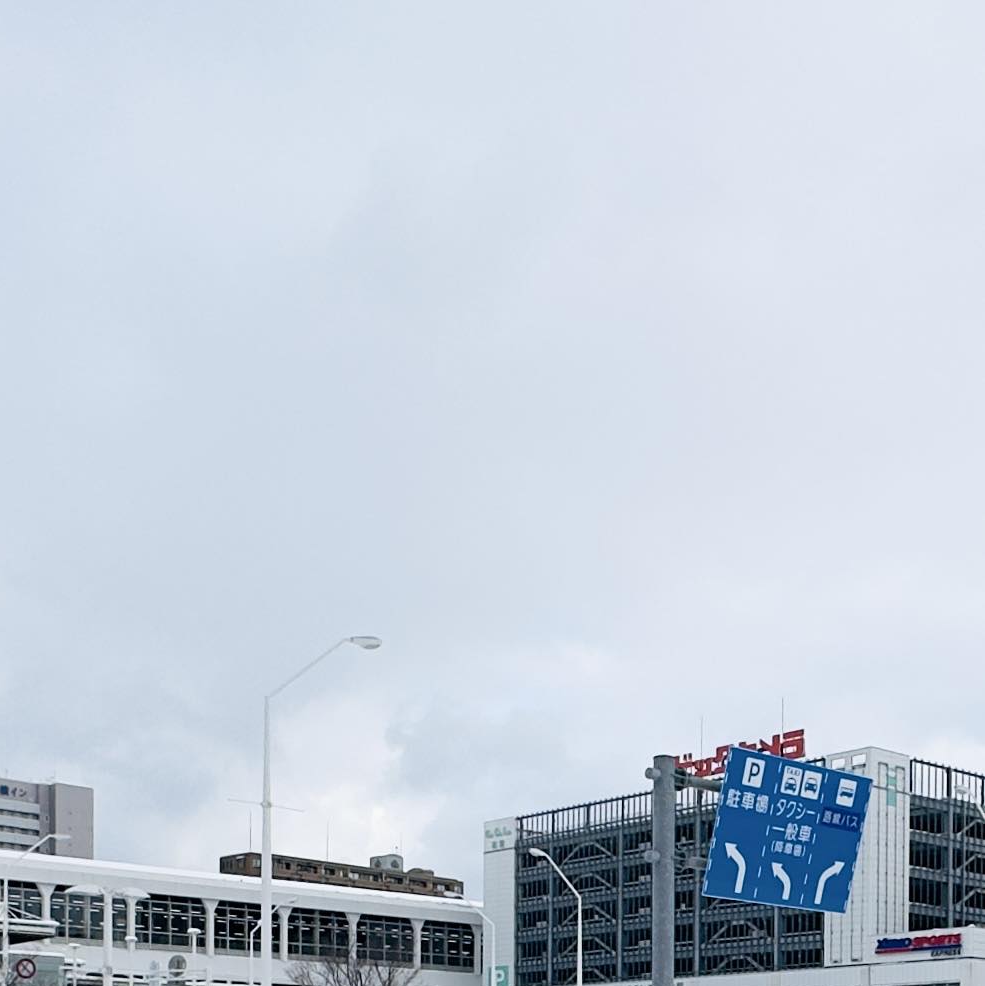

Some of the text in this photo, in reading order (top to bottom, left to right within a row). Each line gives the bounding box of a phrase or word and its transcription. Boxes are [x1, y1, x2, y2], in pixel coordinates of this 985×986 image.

[747, 762, 761, 783] P
[775, 799, 816, 820] タクシー
[771, 822, 813, 843] 一般車
